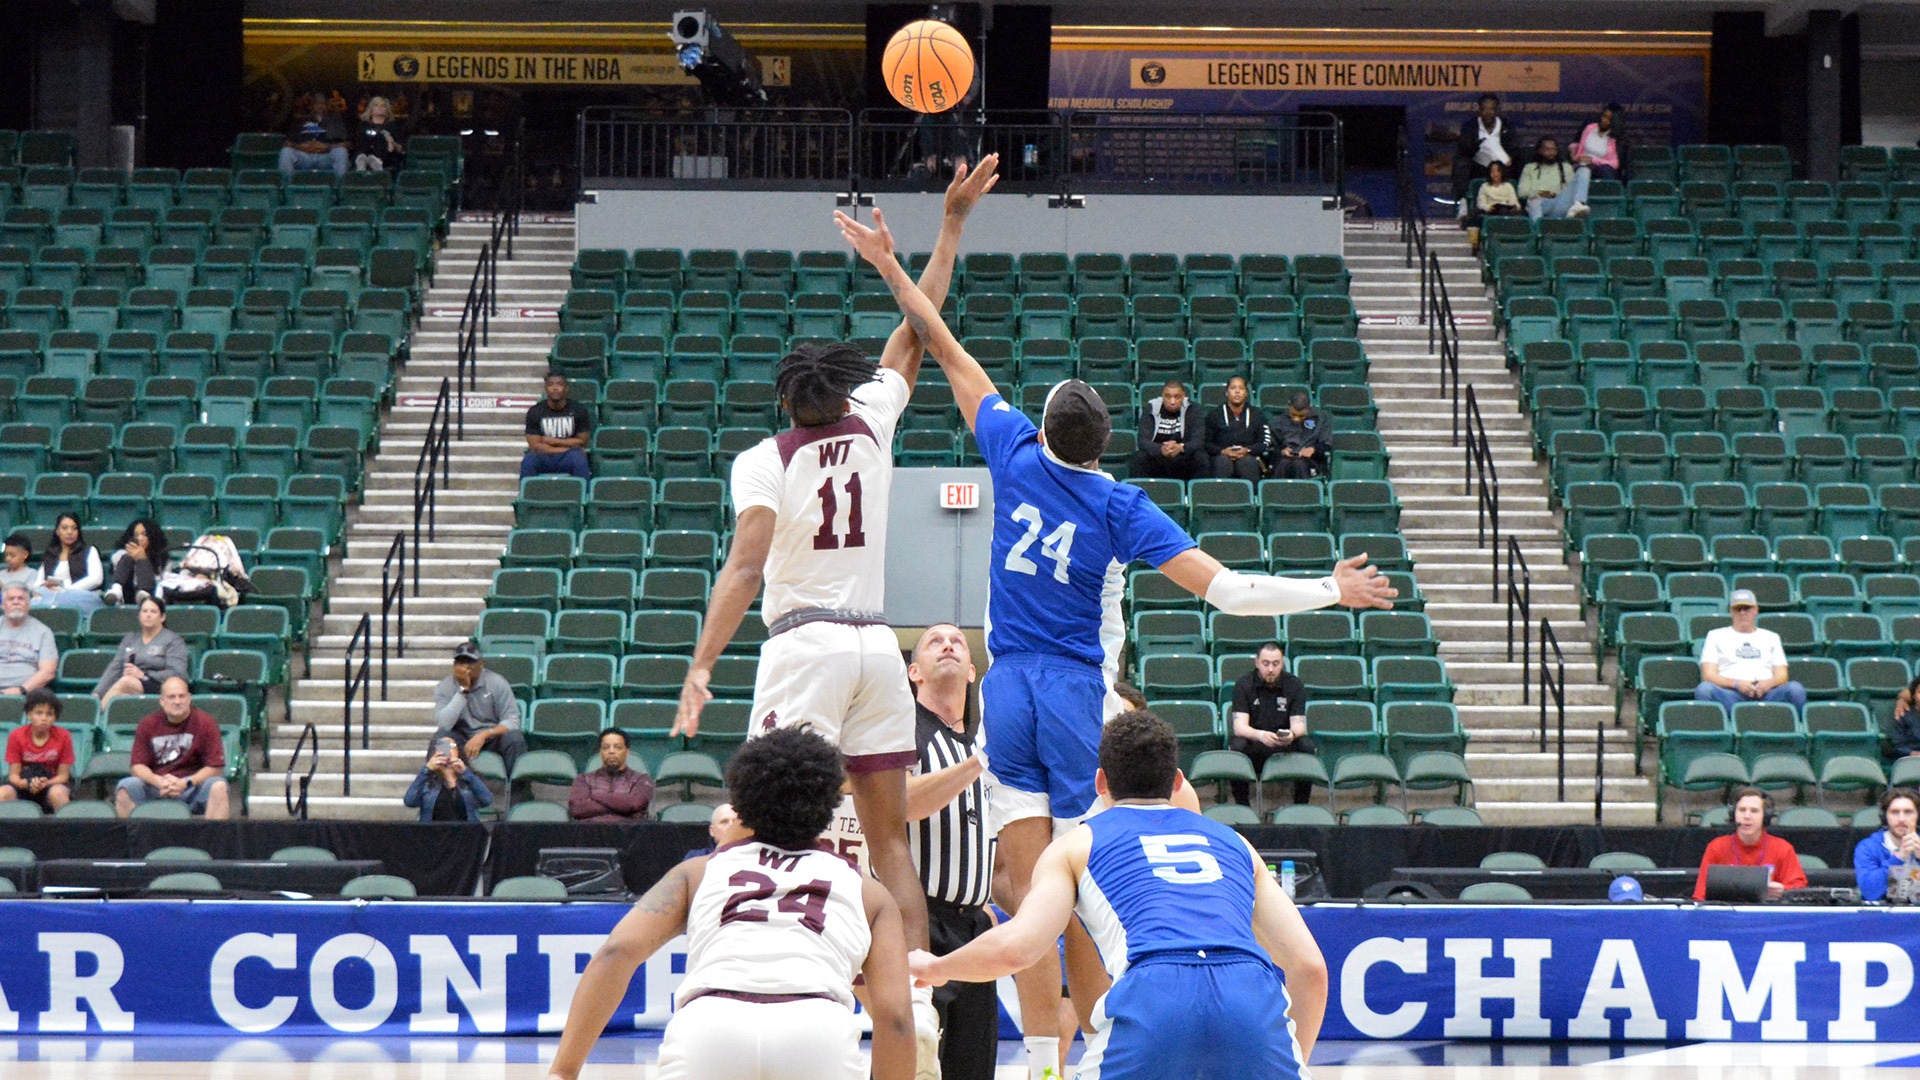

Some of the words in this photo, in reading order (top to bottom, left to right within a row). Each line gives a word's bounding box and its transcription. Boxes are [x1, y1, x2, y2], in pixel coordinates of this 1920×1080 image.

[426, 55, 509, 79] LEGENDS
[514, 56, 537, 79] IN
[543, 57, 577, 80] THE
[583, 57, 622, 80] NBA
[1208, 63, 1290, 86] LEGENDS
[1295, 63, 1317, 86] IN
[1323, 63, 1357, 87] THE
[1363, 63, 1483, 88] COMMUNITY
[1070, 98, 1115, 109] MEMORIAL
[1117, 98, 1175, 110] SCHOLARSHIP
[1396, 316, 1420, 326] FOOD
[468, 397, 498, 409] COURT
[541, 416, 575, 438] WIN
[818, 438, 854, 469] WT
[947, 484, 974, 506] EXIT
[813, 471, 866, 551] 11
[1004, 502, 1077, 585] 24
[758, 847, 812, 873] WT
[1138, 833, 1225, 885] 5
[719, 869, 832, 936] 24
[1340, 936, 1915, 1042] CHAMP
